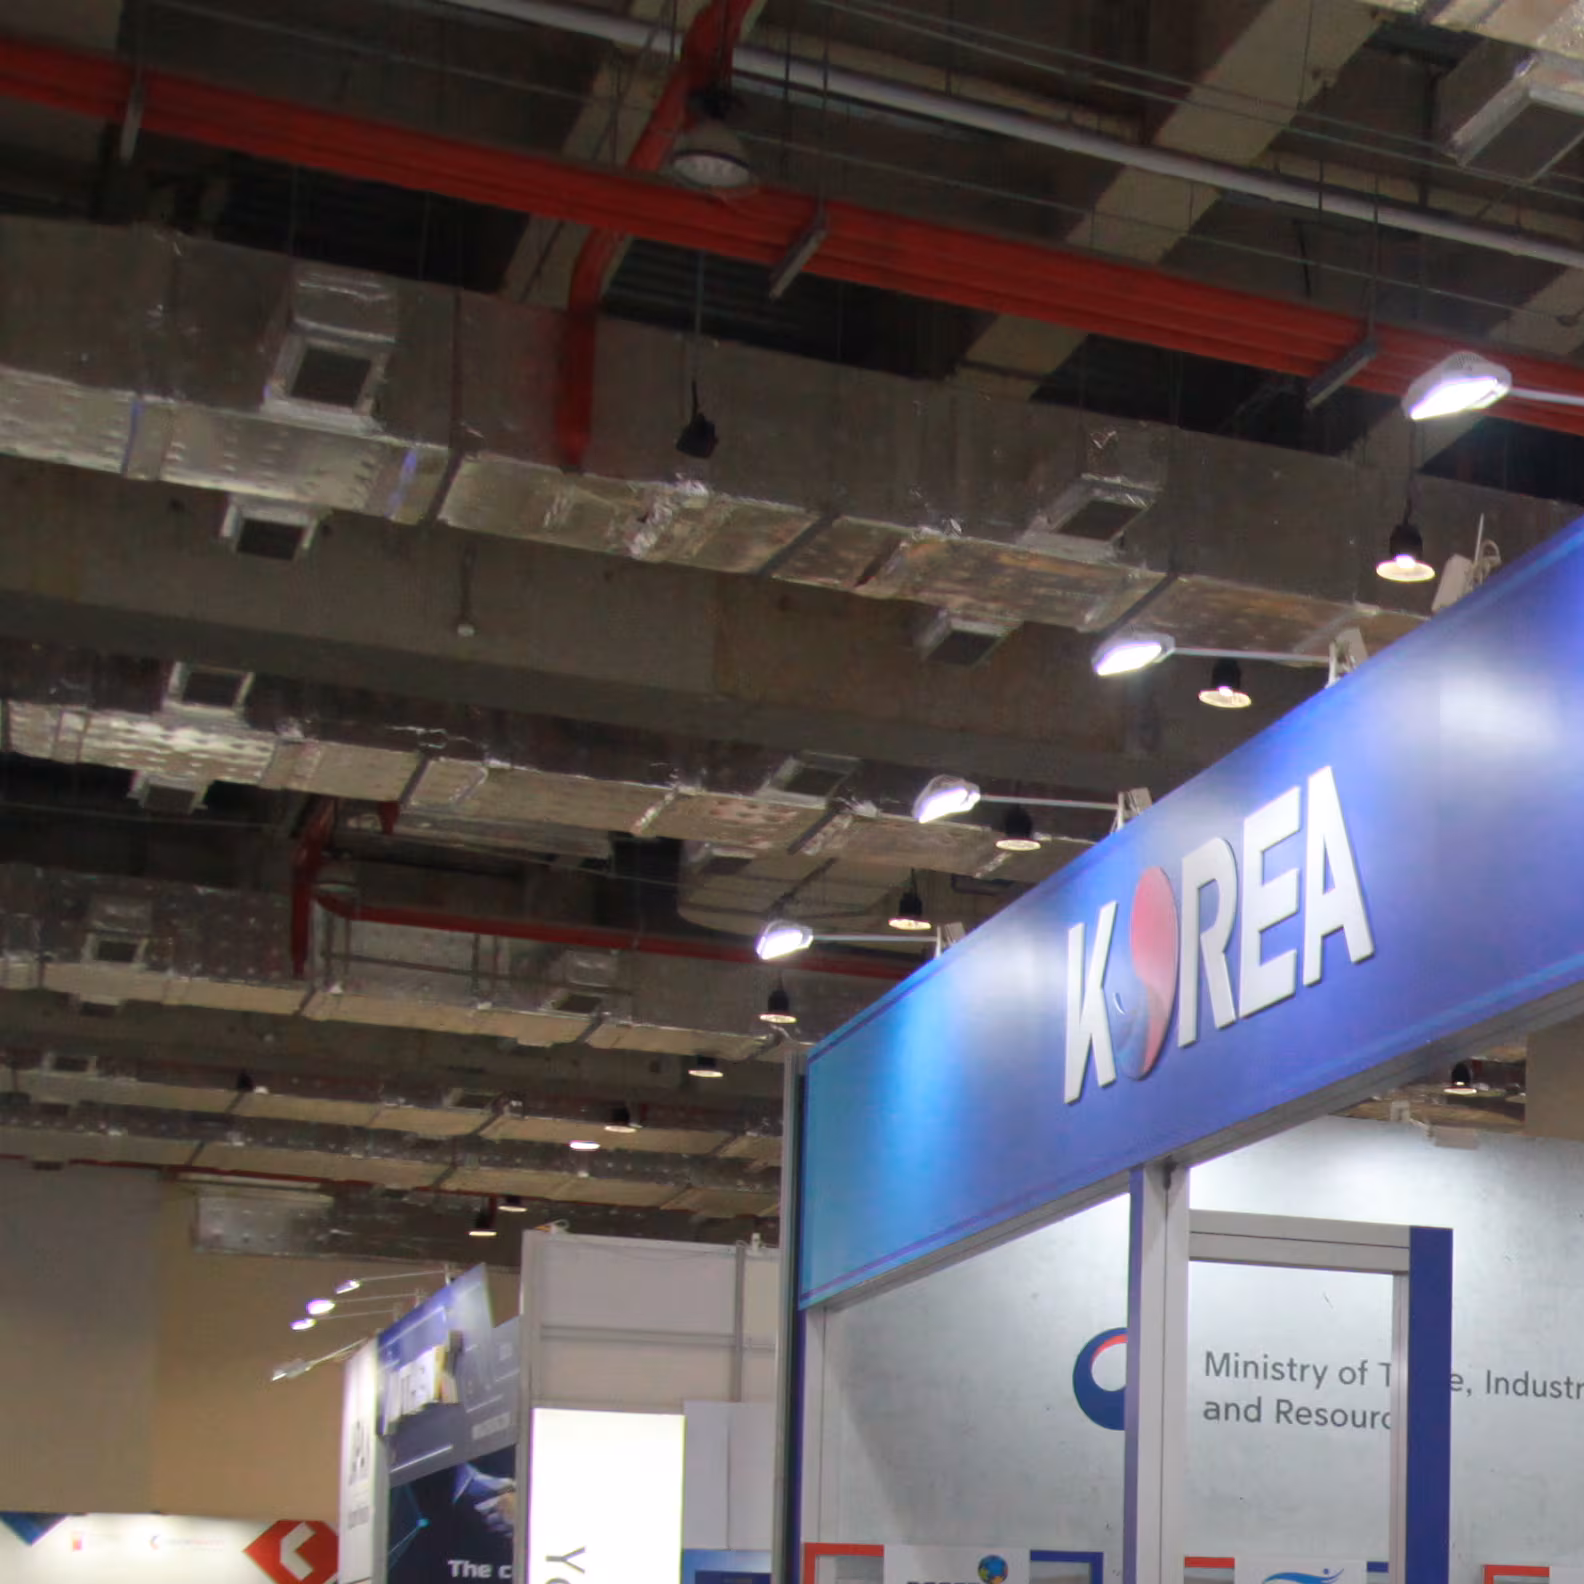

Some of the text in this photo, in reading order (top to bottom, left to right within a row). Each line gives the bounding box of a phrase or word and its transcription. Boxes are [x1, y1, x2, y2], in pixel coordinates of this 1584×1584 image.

[1063, 766, 1377, 1104] KOREA
[1204, 1350, 1328, 1390] Ministry
[1338, 1358, 1368, 1386] of
[1203, 1395, 1392, 1430] and Resourc
[447, 1559, 492, 1579] The
